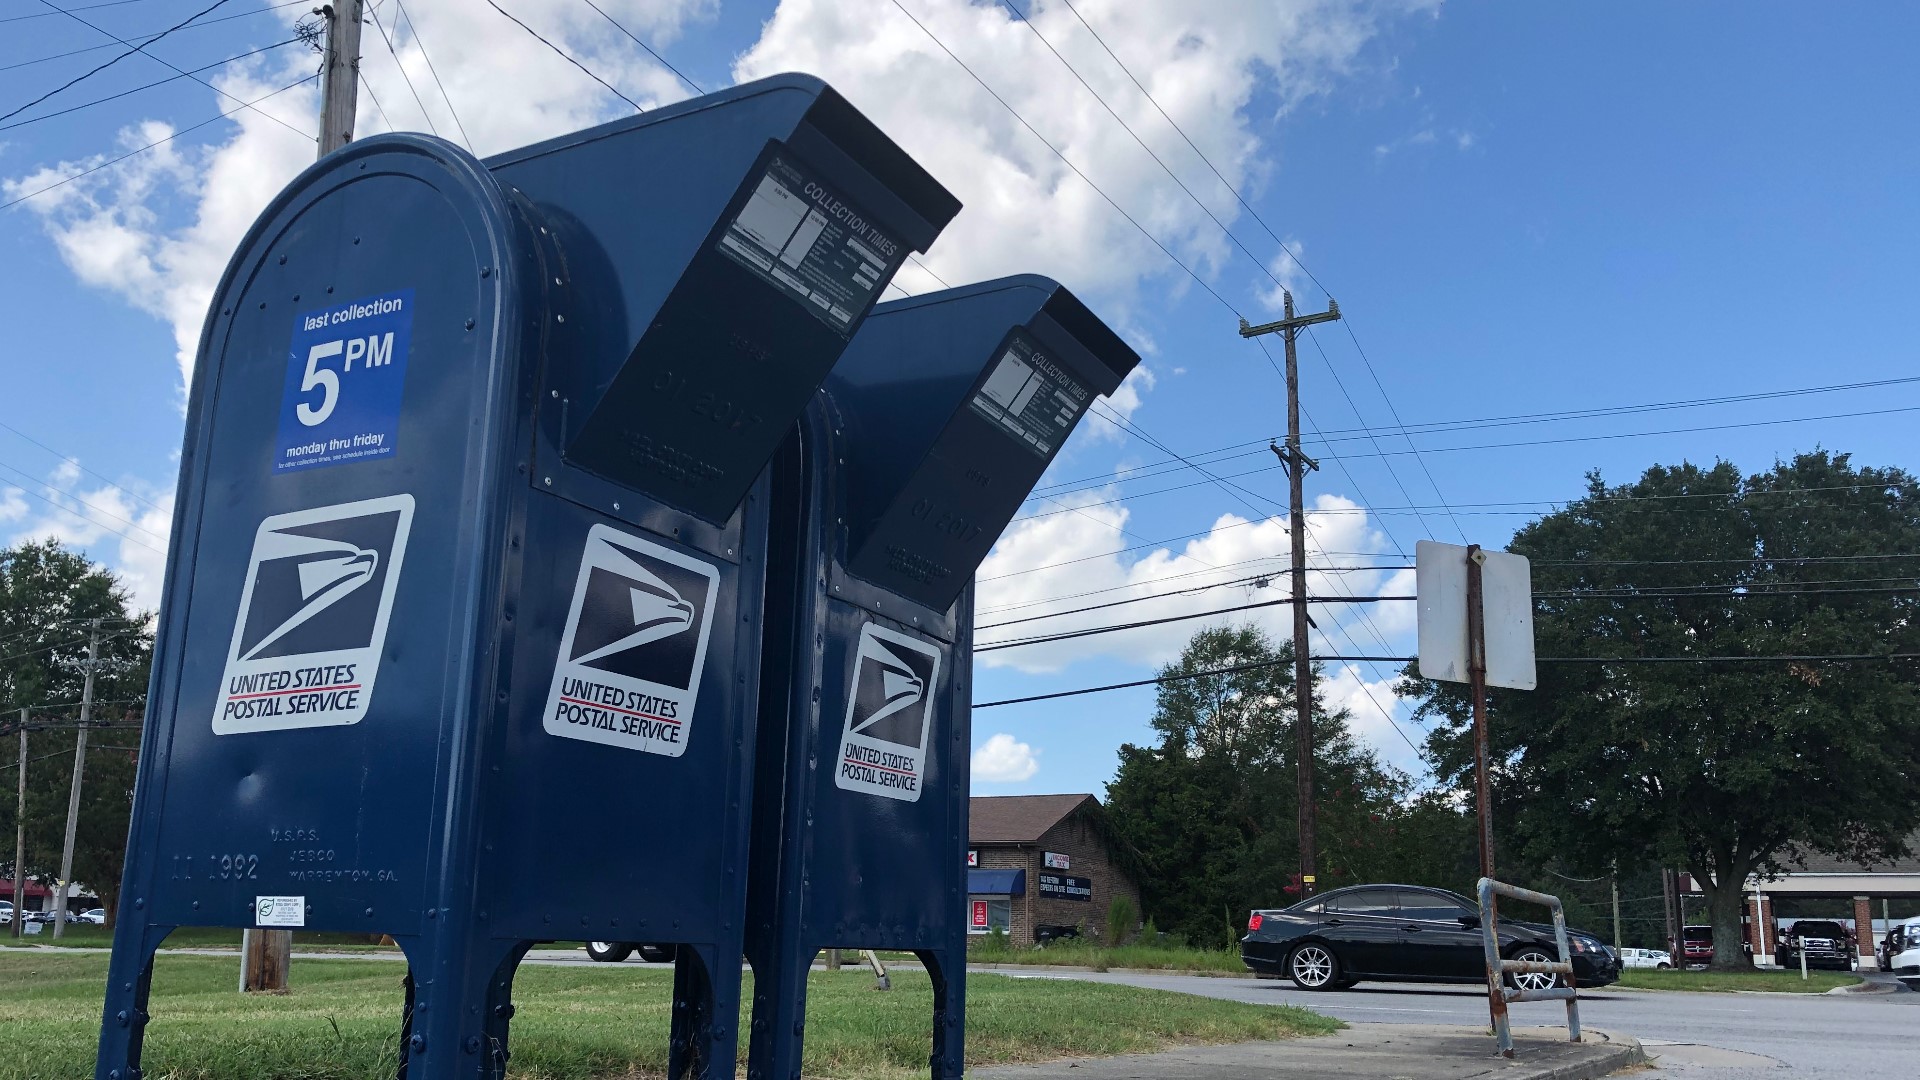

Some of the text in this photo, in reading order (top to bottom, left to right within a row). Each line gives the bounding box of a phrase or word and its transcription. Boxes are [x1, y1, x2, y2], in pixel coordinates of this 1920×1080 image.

[804, 182, 869, 236] COLLECTION
[867, 228, 898, 258] TIMES
[304, 298, 402, 331] last collection
[296, 332, 394, 427] 5 PM
[1031, 352, 1072, 388] COLLECTION
[1068, 381, 1088, 401] TIMES
[286, 432, 385, 458] monday thru friday
[229, 663, 357, 695] UNITED STATES
[223, 689, 360, 721] POSTAL SERVICE
[561, 676, 678, 718] UNITED STATES
[555, 702, 681, 744] POSTAL SERVICE
[845, 742, 914, 771] UNITED STATES
[841, 763, 917, 791] POSTAL SERVICE
[209, 854, 258, 880] 1992
[1066, 878, 1076, 886] FREE
